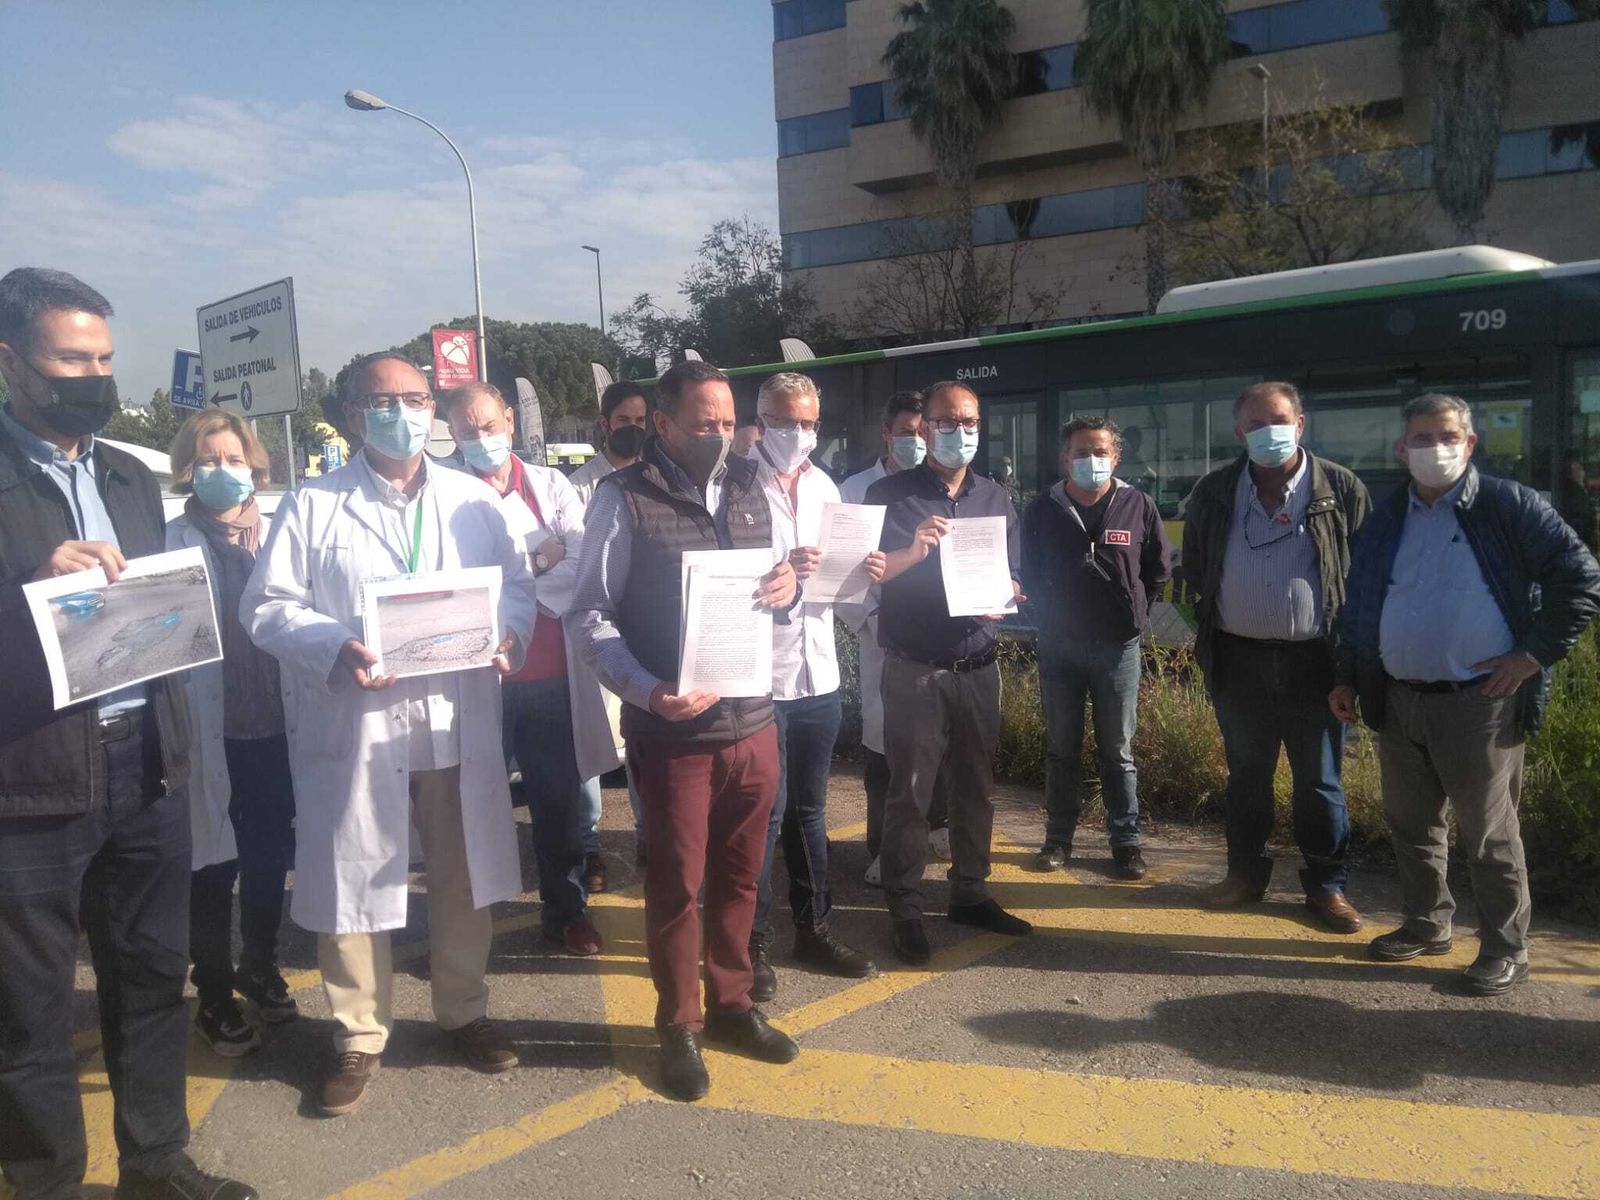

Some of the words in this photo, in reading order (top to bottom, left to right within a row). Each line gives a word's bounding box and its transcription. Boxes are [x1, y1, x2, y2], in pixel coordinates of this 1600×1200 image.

[205, 313, 228, 332] SALIDA
[229, 310, 240, 325] DE
[240, 296, 282, 322] VEHICULOS
[1459, 308, 1506, 332] 709
[213, 366, 237, 383] SALIDA
[238, 356, 277, 377] PEATONAL
[956, 365, 998, 380] SALIDA
[1110, 533, 1127, 542] CTA
